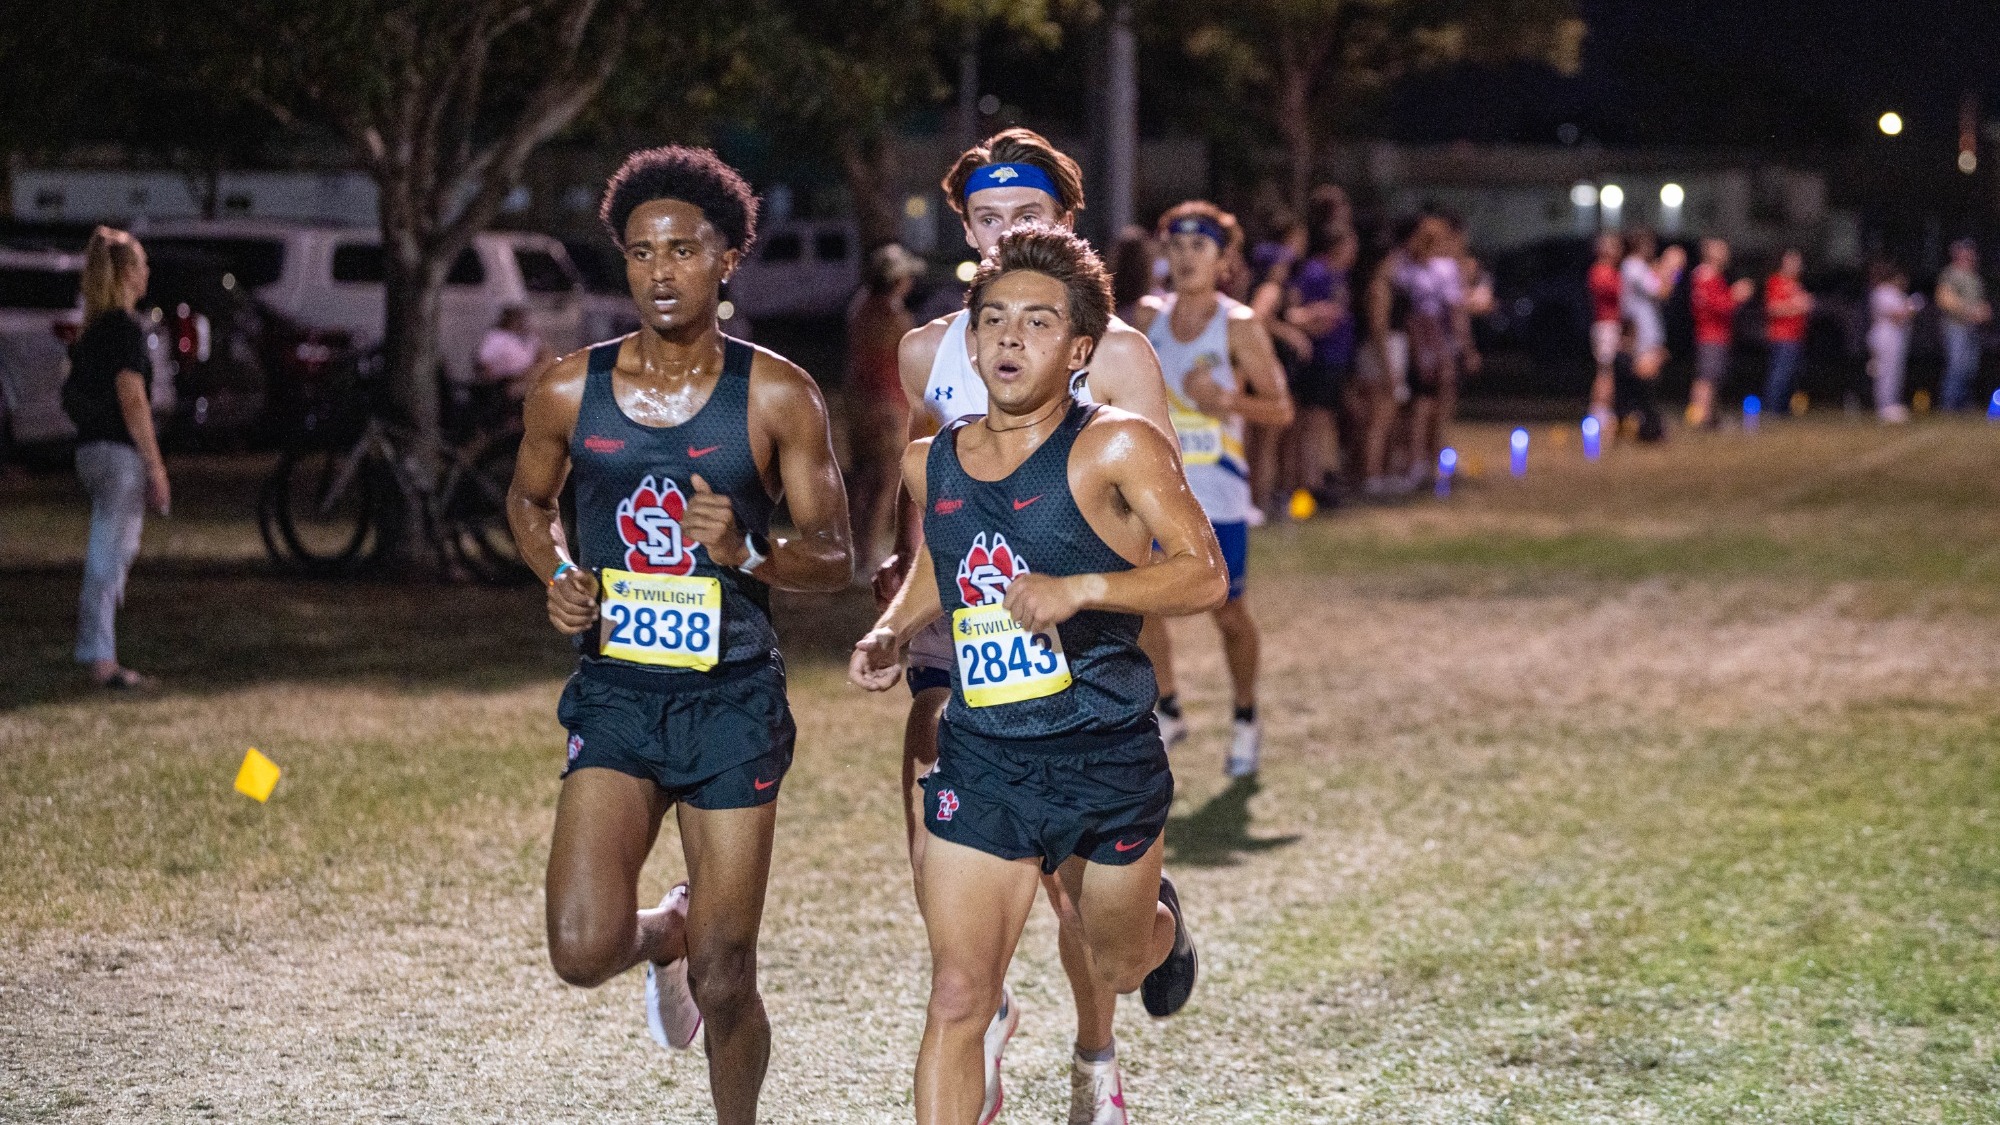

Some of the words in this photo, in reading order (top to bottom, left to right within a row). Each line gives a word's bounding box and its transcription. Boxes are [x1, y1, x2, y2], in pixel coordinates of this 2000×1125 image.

[633, 588, 706, 606] TWILIGHT
[609, 604, 711, 653] 2838
[974, 618, 1023, 636] TWILIG
[962, 632, 1058, 686] 2843
